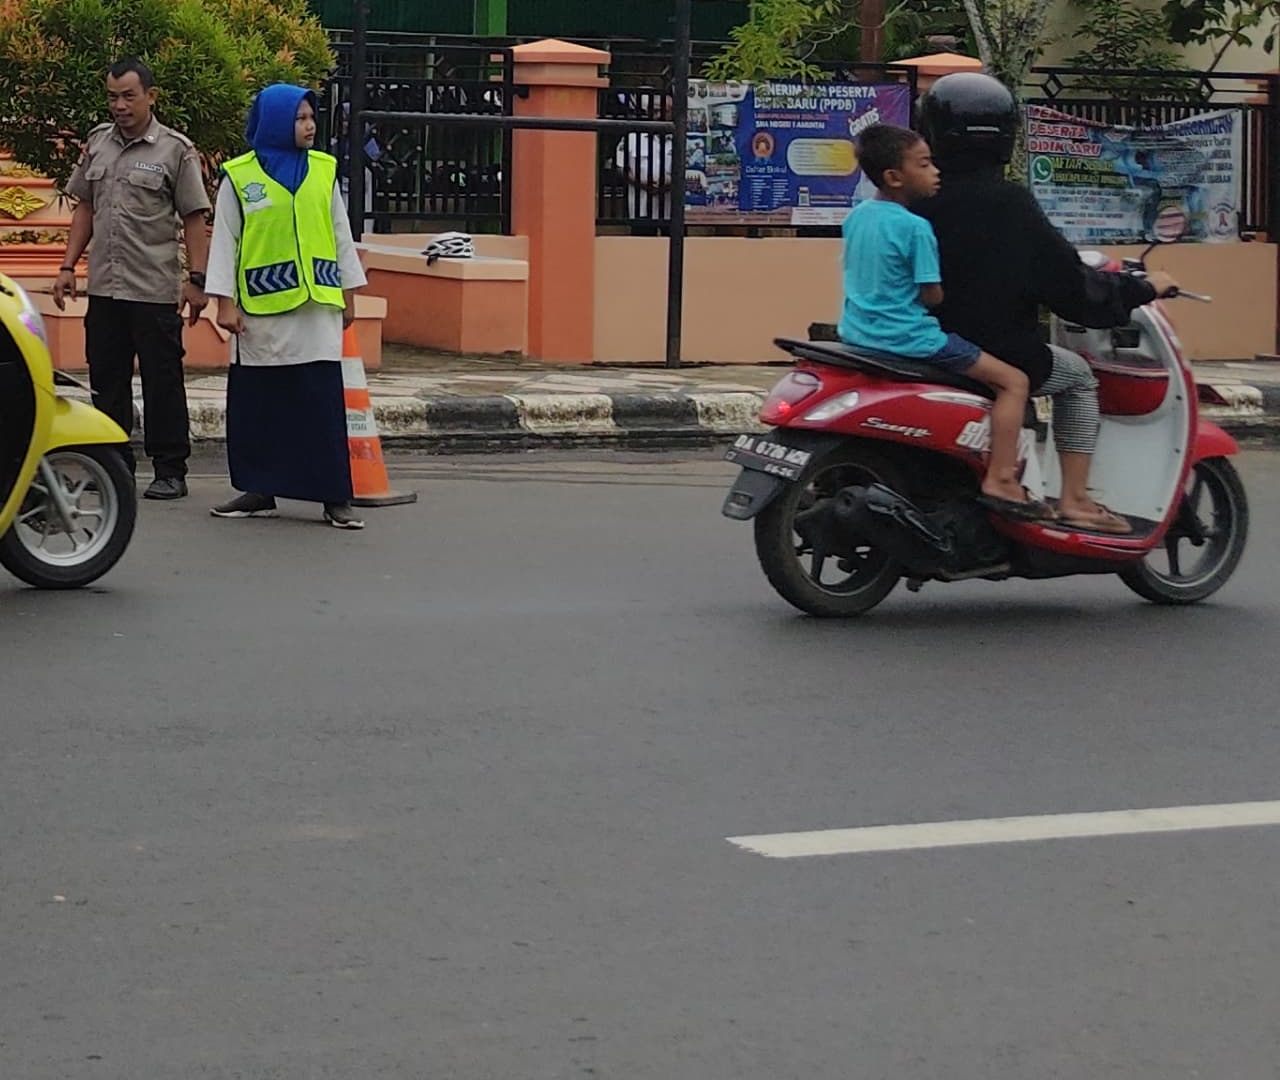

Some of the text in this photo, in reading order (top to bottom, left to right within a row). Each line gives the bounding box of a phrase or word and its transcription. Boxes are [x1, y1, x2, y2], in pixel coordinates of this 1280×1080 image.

[828, 85, 877, 99] PESERTA
[819, 97, 857, 113] (PPDB)
[1028, 124, 1088, 139] PESERTA
